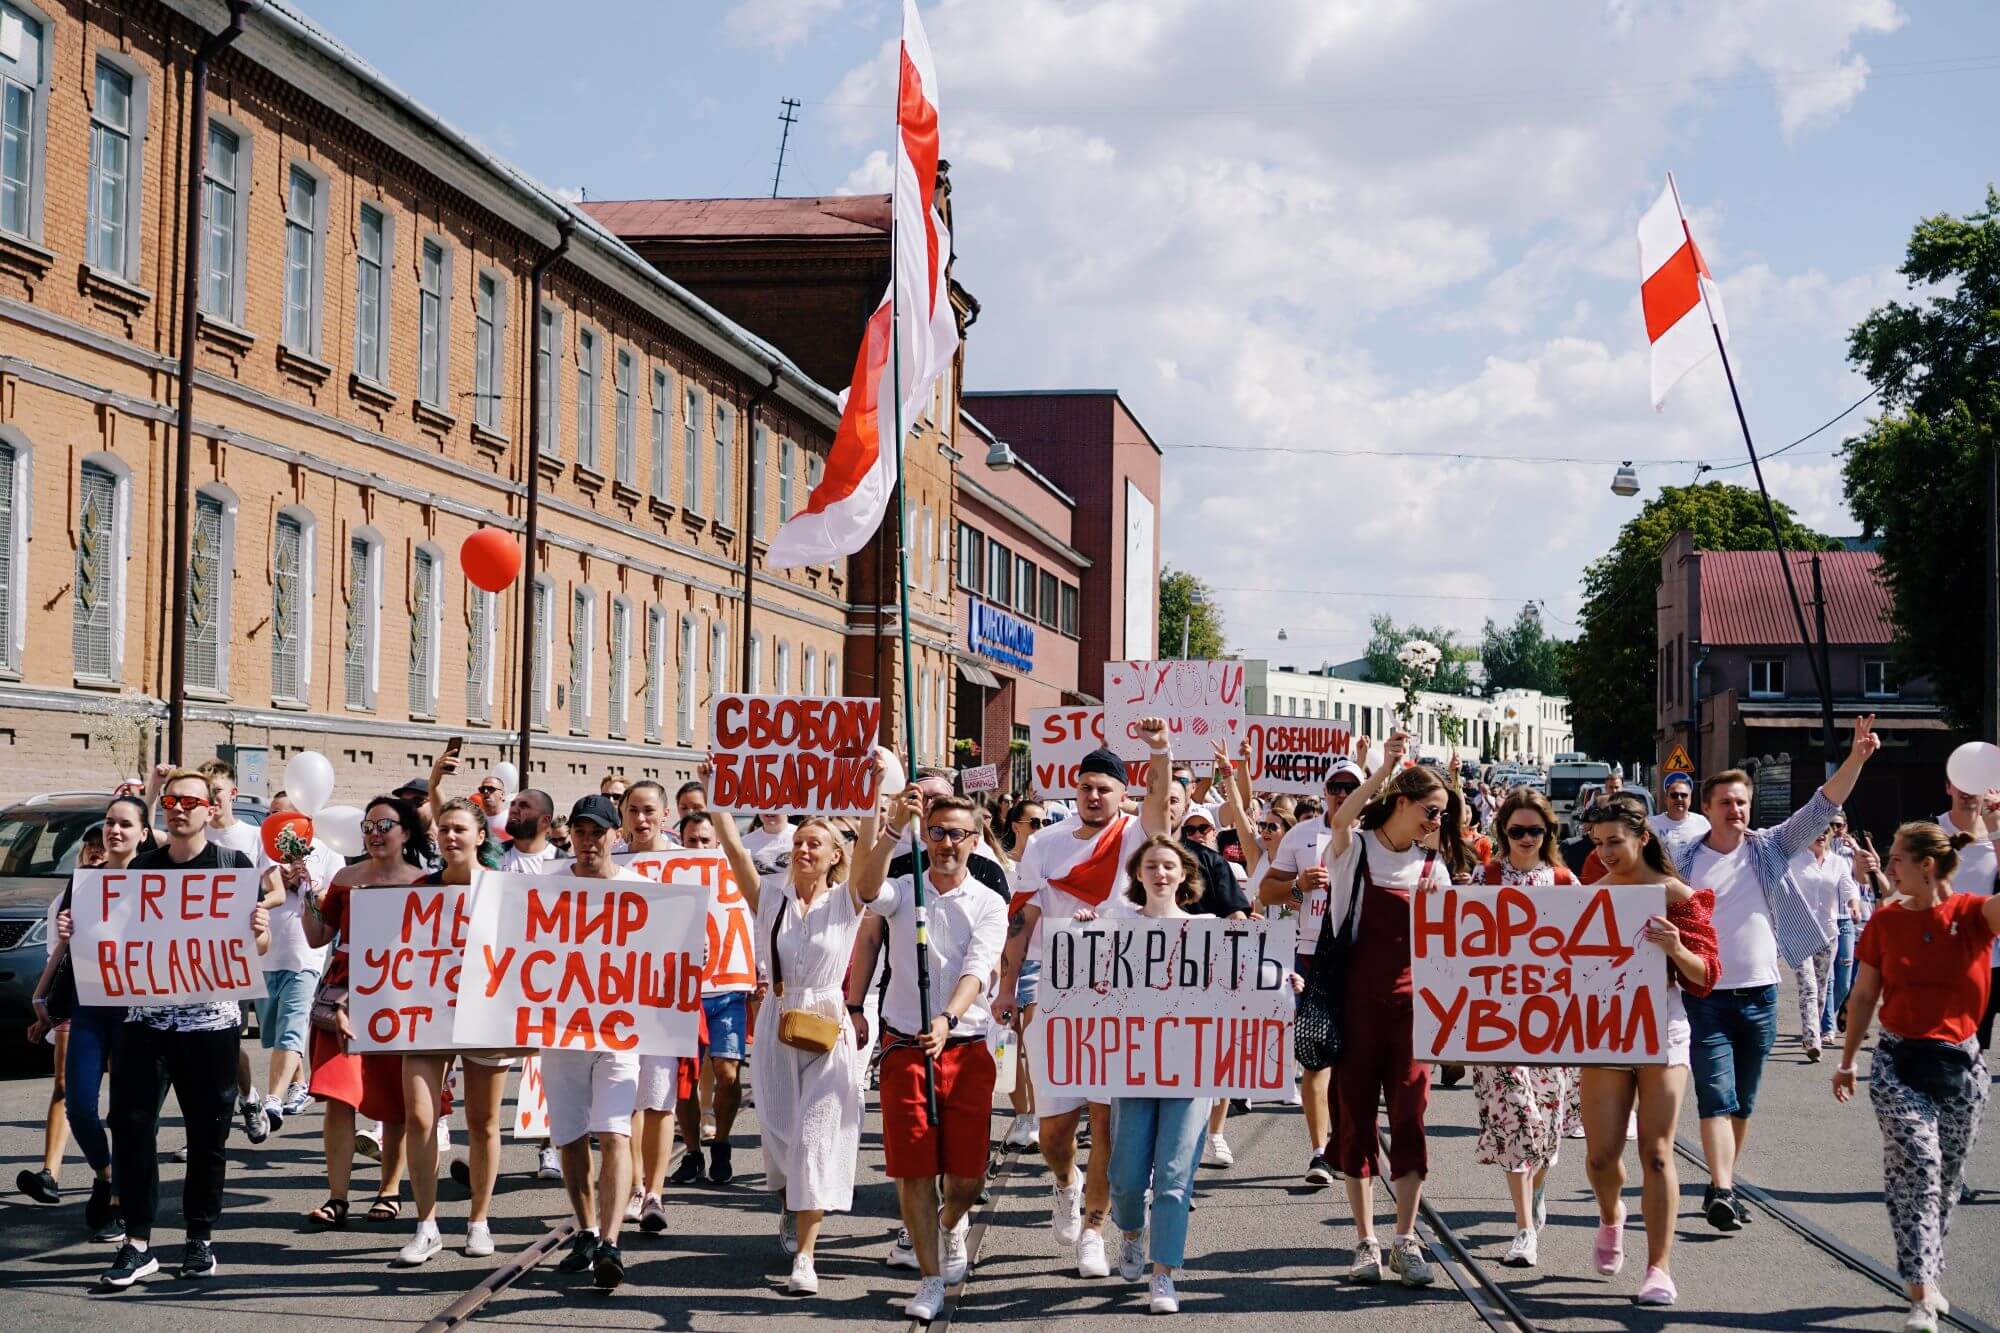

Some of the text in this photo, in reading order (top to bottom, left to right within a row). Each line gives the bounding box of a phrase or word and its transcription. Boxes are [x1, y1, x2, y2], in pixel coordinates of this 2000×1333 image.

[716, 697, 880, 758] СВОБОДУ
[1042, 711, 1104, 744] STO
[713, 752, 877, 810] БАБАРИКО
[102, 874, 236, 922] FREE
[526, 889, 648, 946] МИР
[98, 938, 251, 997] BELARUS
[483, 944, 703, 1012] УСЛЫШЬ
[1051, 930, 1283, 991] ОТКРЫТЬ
[1468, 964, 1572, 998] ТЕБЯ
[368, 1006, 433, 1044] ОТ
[515, 1006, 639, 1050] НАС
[1419, 985, 1660, 1056] УВОЛИЛ
[1046, 1016, 1285, 1089] ОКРЕСТИНО
